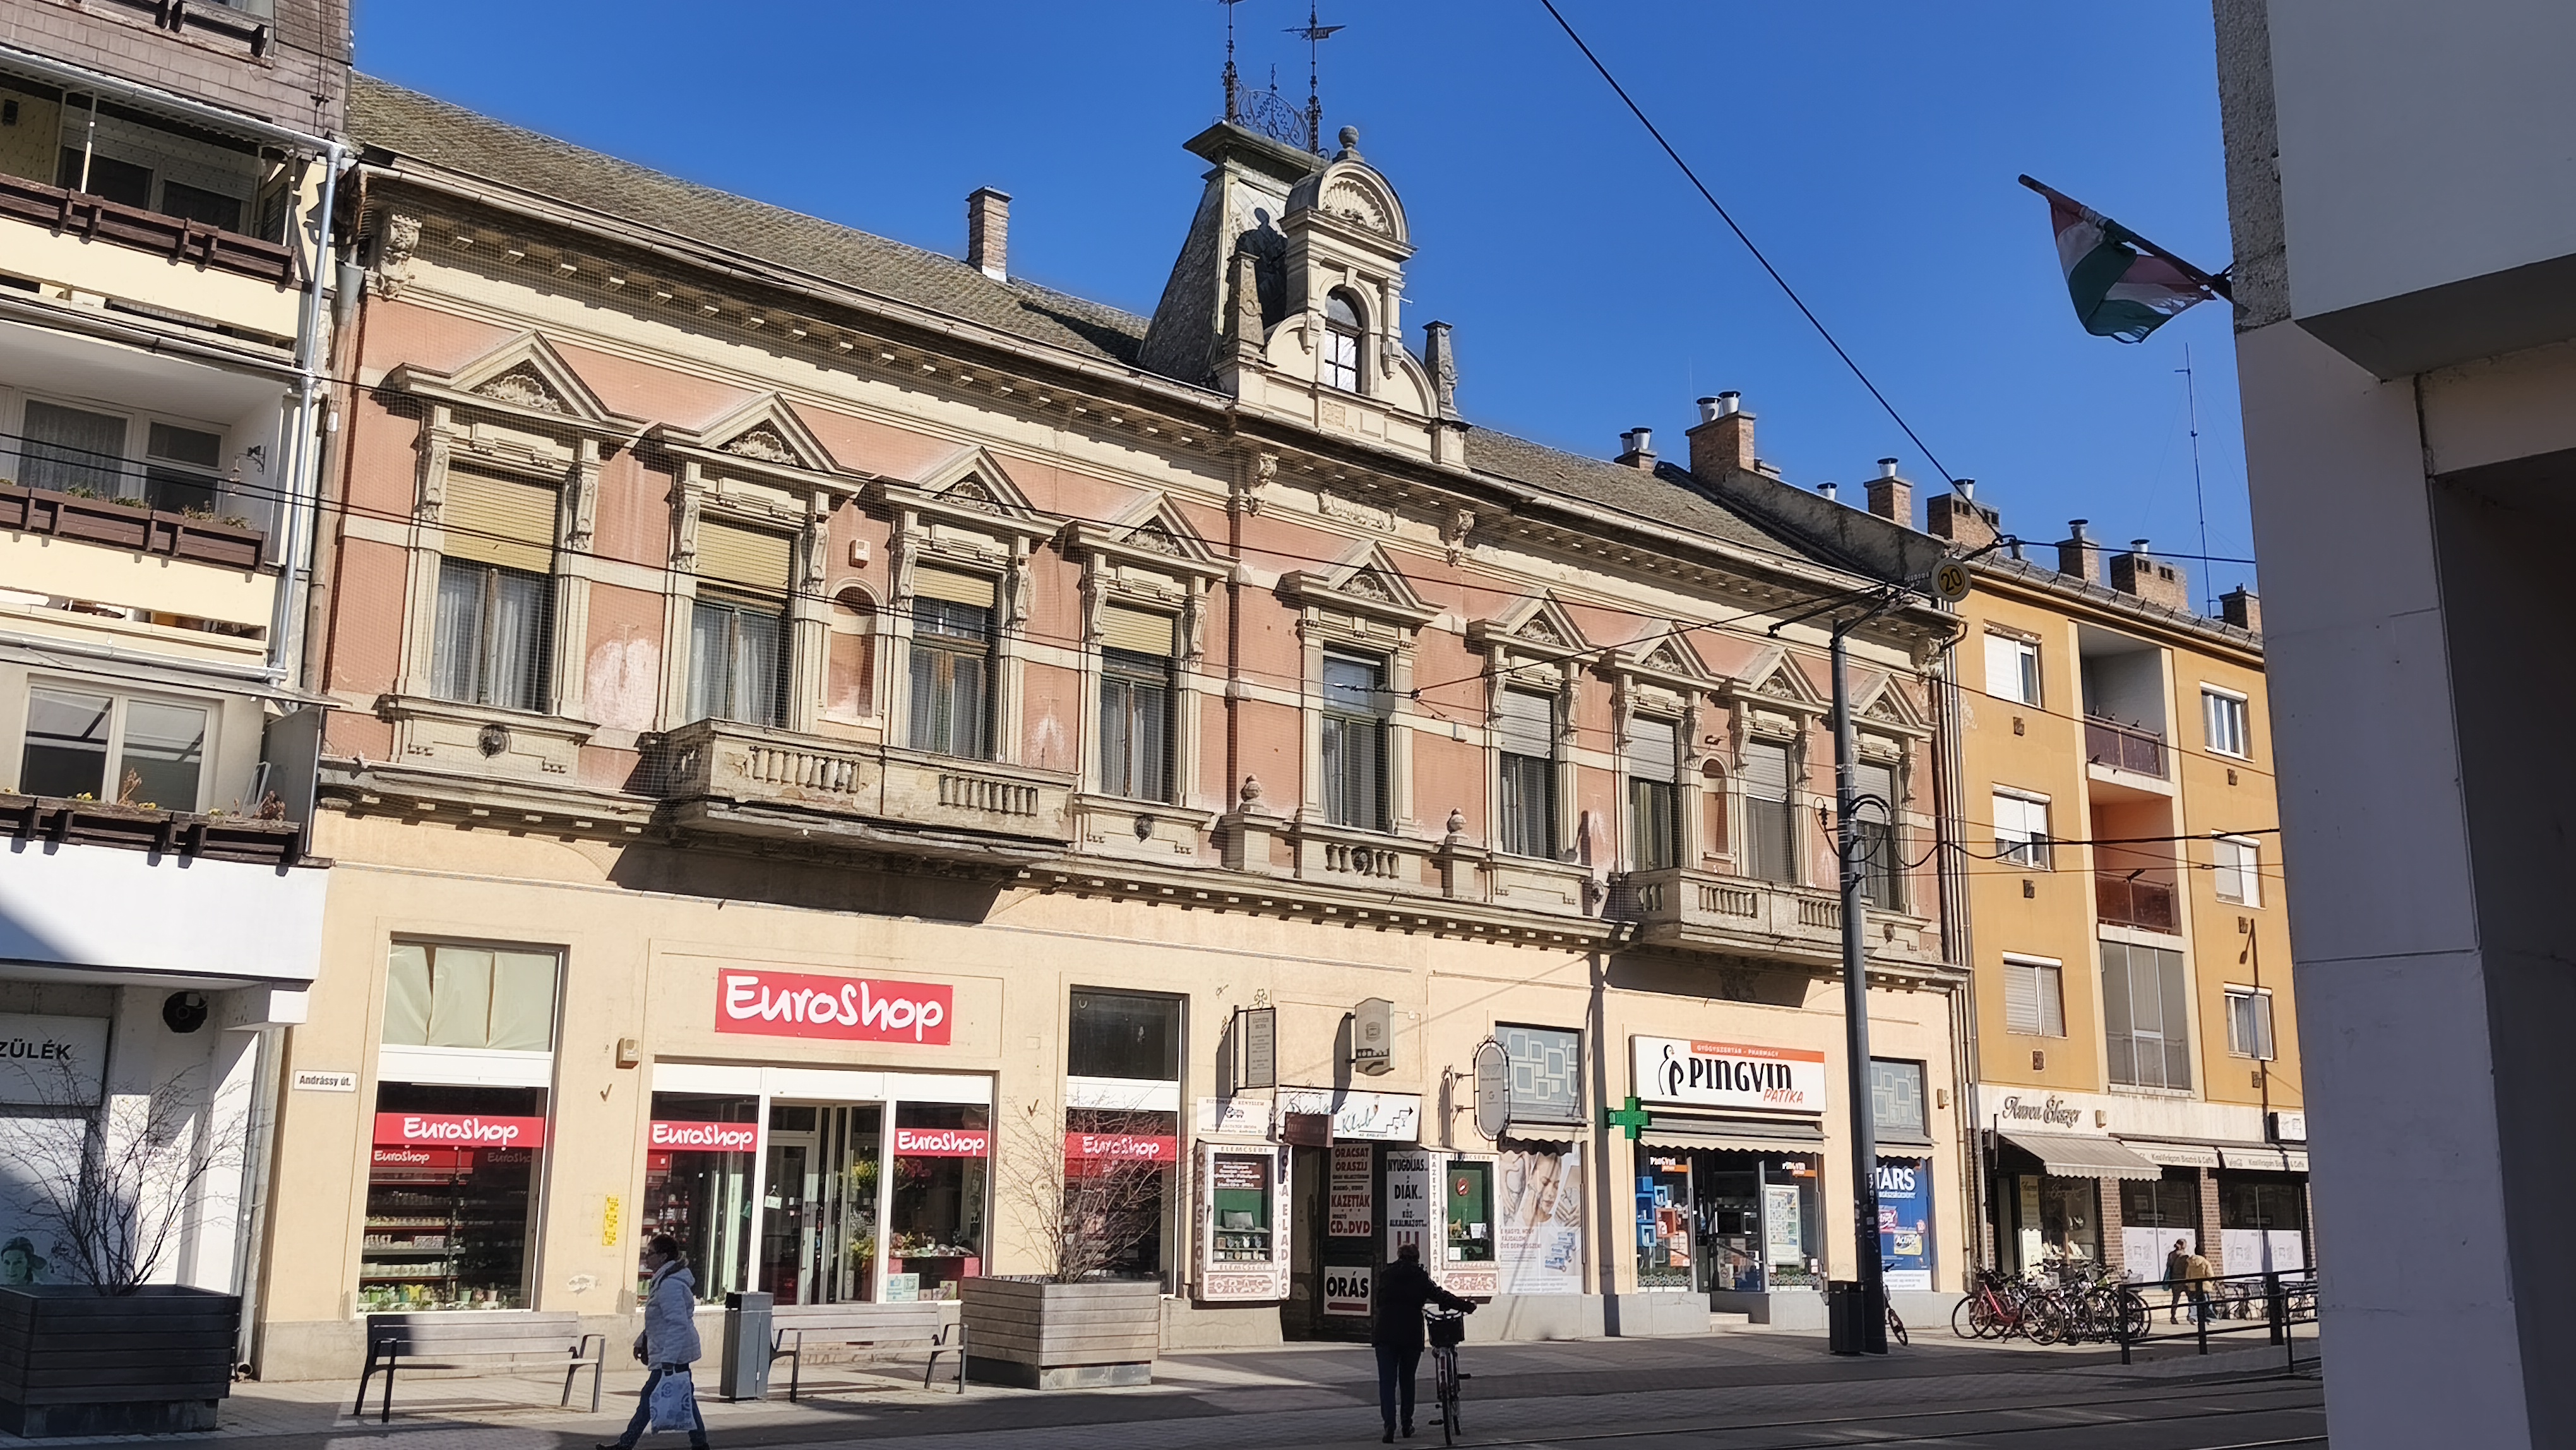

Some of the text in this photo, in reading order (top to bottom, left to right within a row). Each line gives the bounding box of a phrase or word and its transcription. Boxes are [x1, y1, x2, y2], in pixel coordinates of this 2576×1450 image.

[1941, 568, 1962, 592] 20
[725, 974, 944, 1042] EuroShop
[1748, 1048, 1779, 1057] PHARMACY
[299, 1075, 338, 1086] Andrássy
[1688, 1057, 1792, 1093] PINGVIN
[1763, 1086, 1804, 1104] PATIKA
[403, 1117, 519, 1146] EuroShop
[652, 1123, 753, 1151] EuroShop
[897, 1131, 985, 1156] EuroShop
[1335, 1146, 1369, 1158] ÓRACSAT
[374, 1150, 430, 1164] EuroShop
[1331, 1192, 1370, 1207] KAZETTÁK
[1330, 1220, 1343, 1233] CD
[1349, 1220, 1370, 1234] DVD
[1326, 1271, 1369, 1298] ÓRÁS
